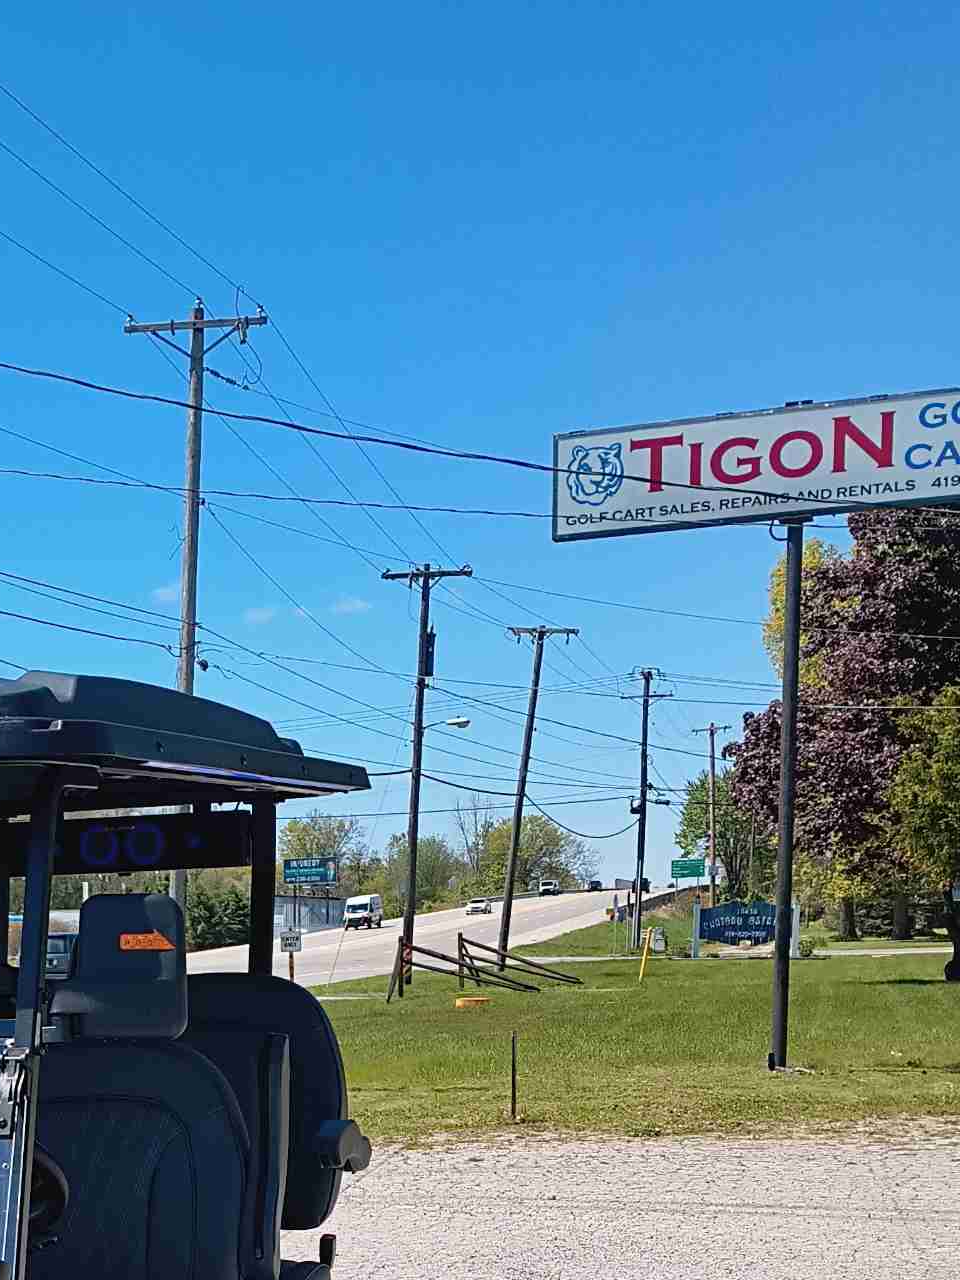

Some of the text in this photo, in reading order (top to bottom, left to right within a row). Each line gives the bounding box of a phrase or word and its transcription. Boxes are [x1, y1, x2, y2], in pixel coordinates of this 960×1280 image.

[918, 402, 960, 429] G
[630, 410, 896, 493] TIGON
[566, 511, 613, 527] GOLF
[612, 505, 655, 522] CART
[719, 490, 790, 511] REPAIRS
[796, 488, 832, 503] AND
[836, 479, 917, 500] RENTALS
